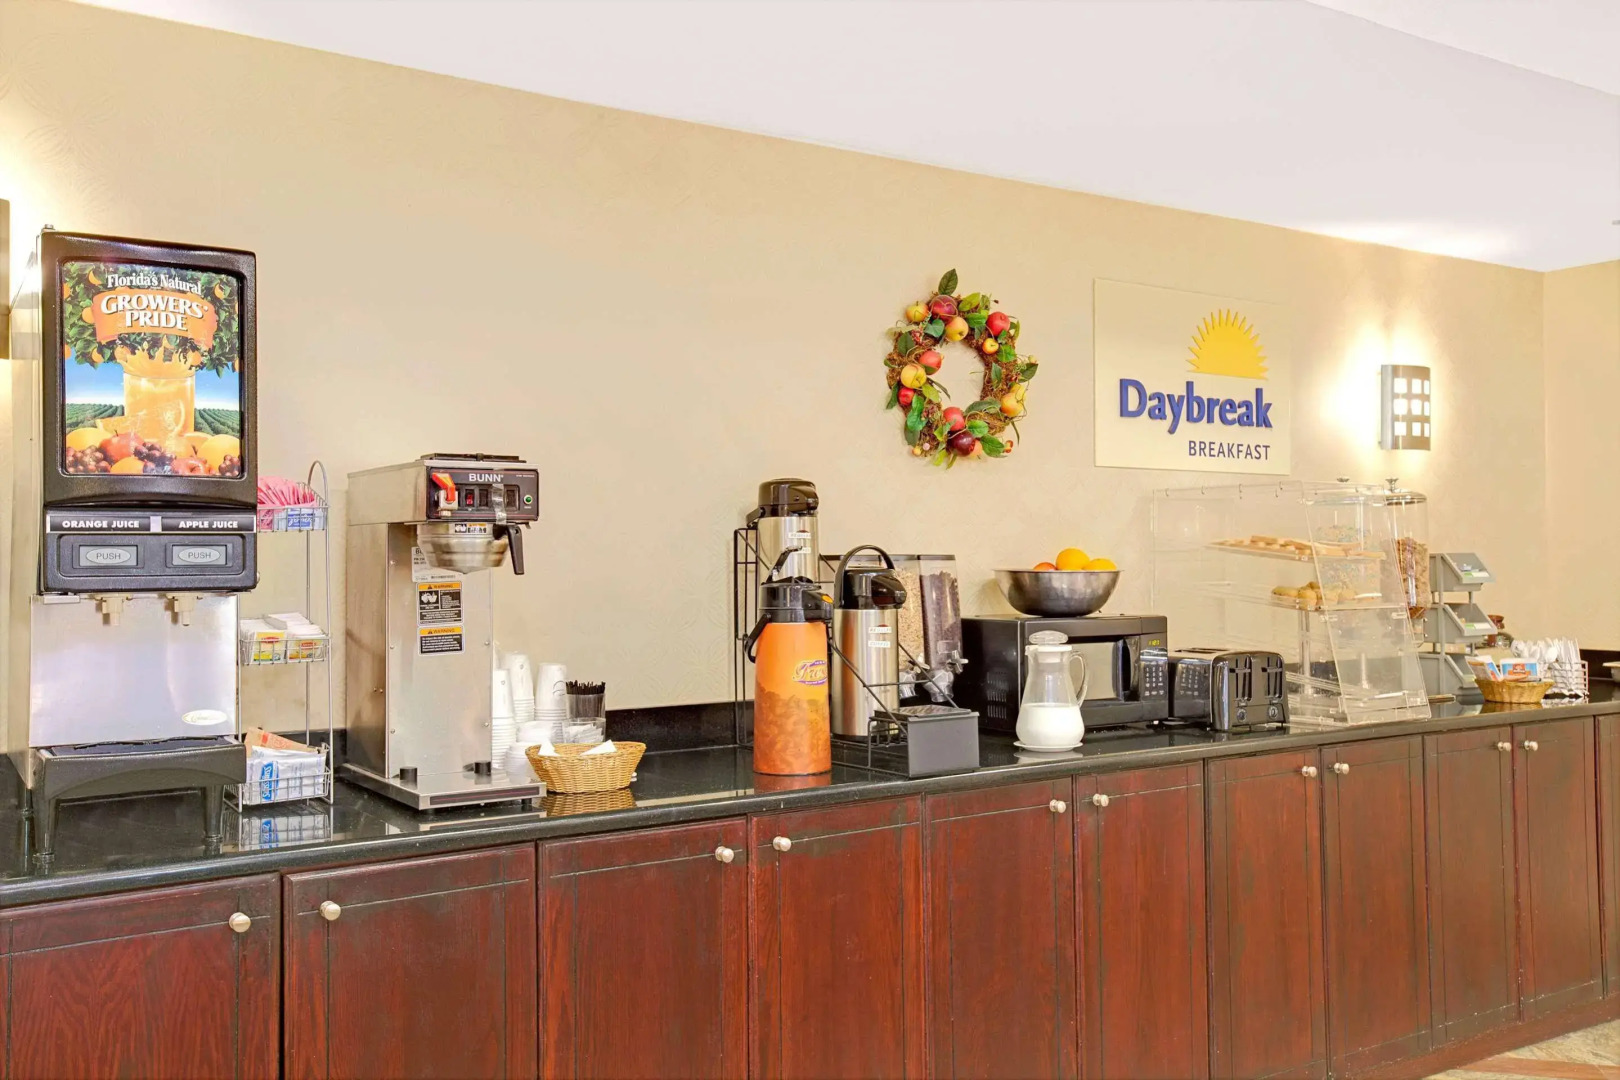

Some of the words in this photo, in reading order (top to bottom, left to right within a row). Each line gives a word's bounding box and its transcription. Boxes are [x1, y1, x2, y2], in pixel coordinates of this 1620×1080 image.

[107, 271, 158, 289] Florida's
[160, 274, 202, 296] Natural
[125, 310, 188, 331] PRIDE
[1119, 378, 1273, 435] Daybreak
[1188, 440, 1271, 460] BREAKFAST
[468, 473, 501, 482] BUNN
[62, 520, 108, 529] ORANGE
[111, 520, 140, 529] JUICE
[178, 520, 209, 529] APPLE
[211, 520, 238, 529] JUICE
[96, 552, 121, 560] PUSH
[187, 551, 212, 559] PUSH
